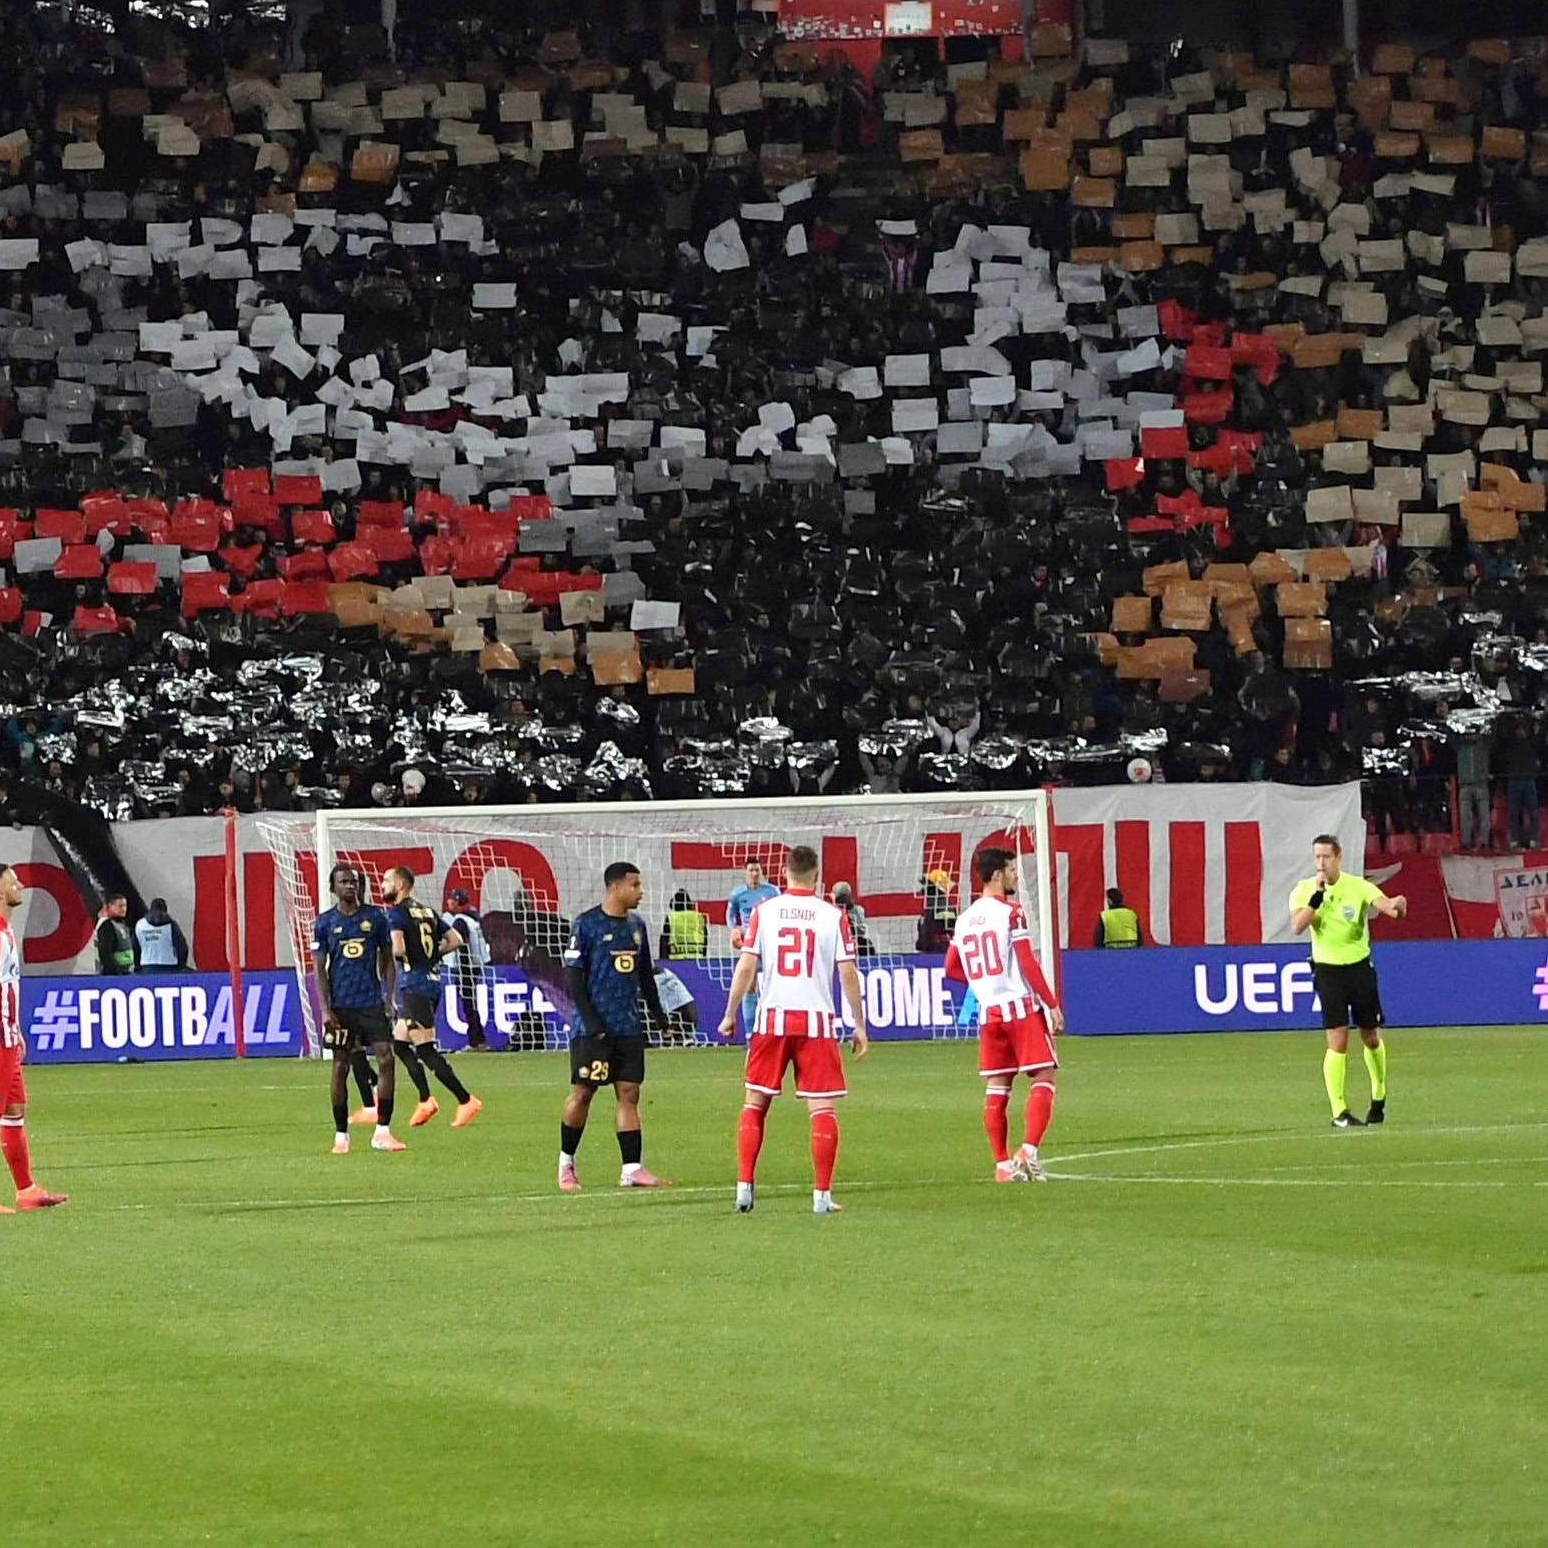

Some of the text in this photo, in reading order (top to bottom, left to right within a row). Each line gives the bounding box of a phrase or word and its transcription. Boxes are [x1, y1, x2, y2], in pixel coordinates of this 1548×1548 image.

[419, 922, 434, 959] 6
[777, 927, 816, 978] 21
[962, 930, 1004, 980] 20
[1194, 962, 1322, 1014] UEF
[30, 984, 291, 1050] #FOOTBALL
[334, 1028, 349, 1046] 17
